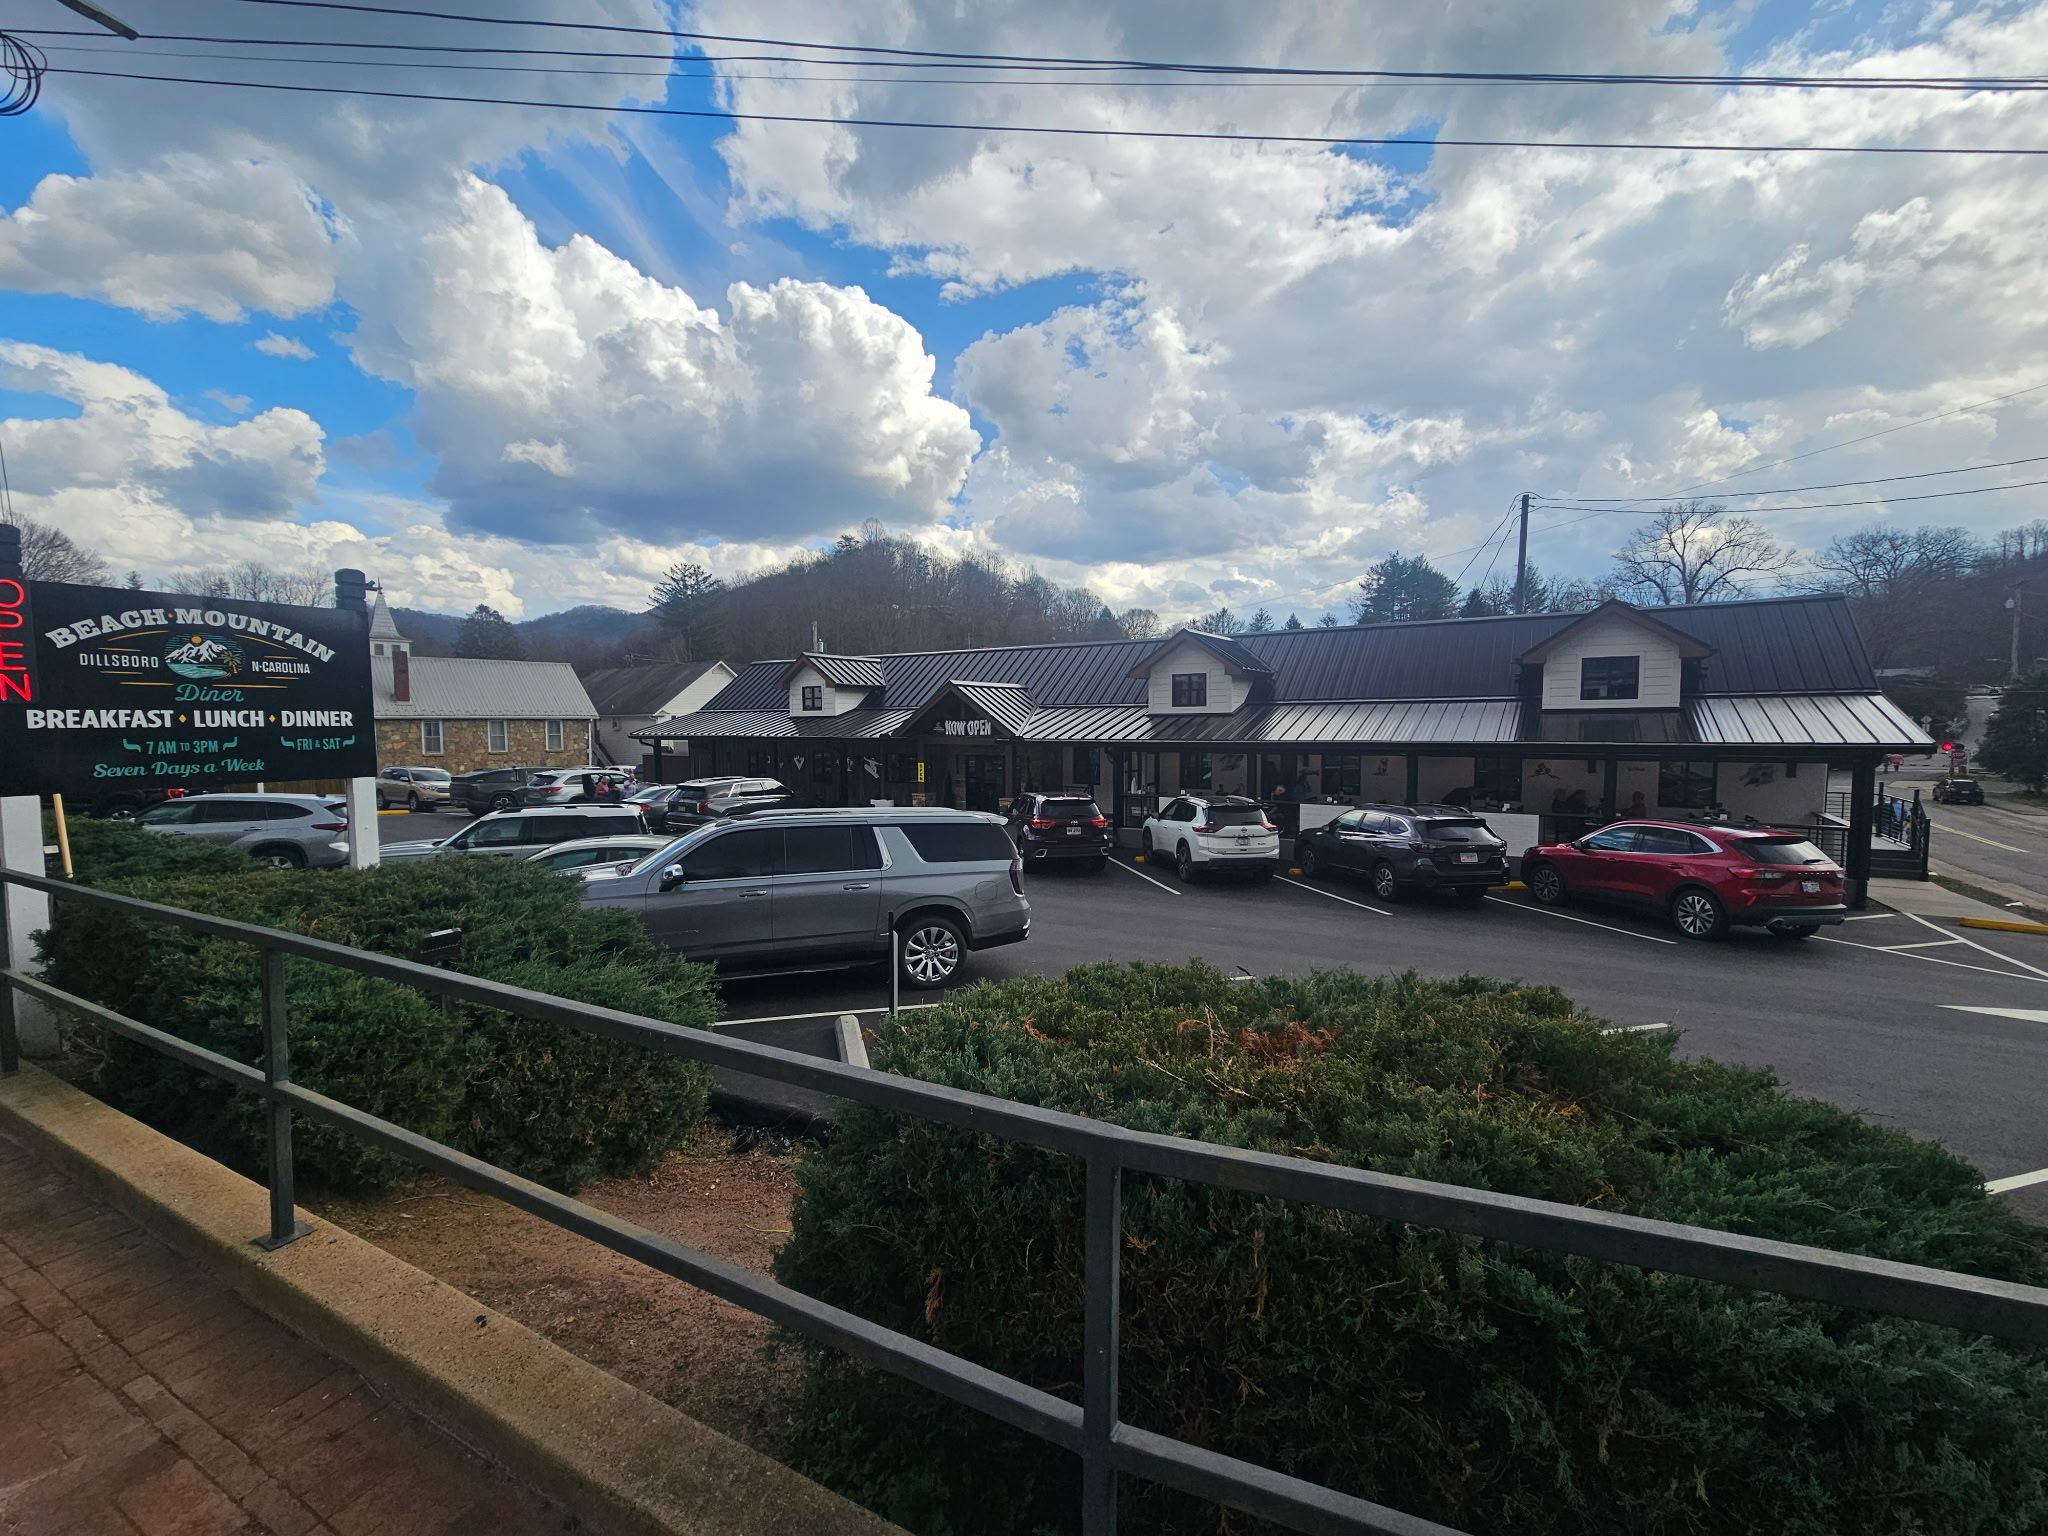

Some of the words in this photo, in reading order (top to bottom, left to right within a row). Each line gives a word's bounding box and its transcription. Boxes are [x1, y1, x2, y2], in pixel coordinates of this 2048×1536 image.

[45, 608, 166, 649] BEACH
[174, 608, 336, 663] MOUNTAIN
[79, 653, 159, 668] DILLSBORO
[175, 683, 244, 702] Diner
[26, 709, 174, 729] BREAKFAST
[193, 709, 265, 728] LUNCH
[281, 710, 354, 727] DINNER
[944, 720, 966, 735] NOW
[967, 720, 991, 735] OPEN
[146, 741, 154, 755] 7
[157, 740, 177, 754] AM
[179, 742, 190, 751] TO
[193, 740, 219, 754] 3PM
[297, 738, 313, 751] FRI
[315, 739, 321, 748] &
[322, 738, 341, 750] SAT
[93, 763, 149, 778] Seven
[151, 761, 201, 778] Days
[203, 763, 218, 773] a
[221, 758, 265, 772] Week
